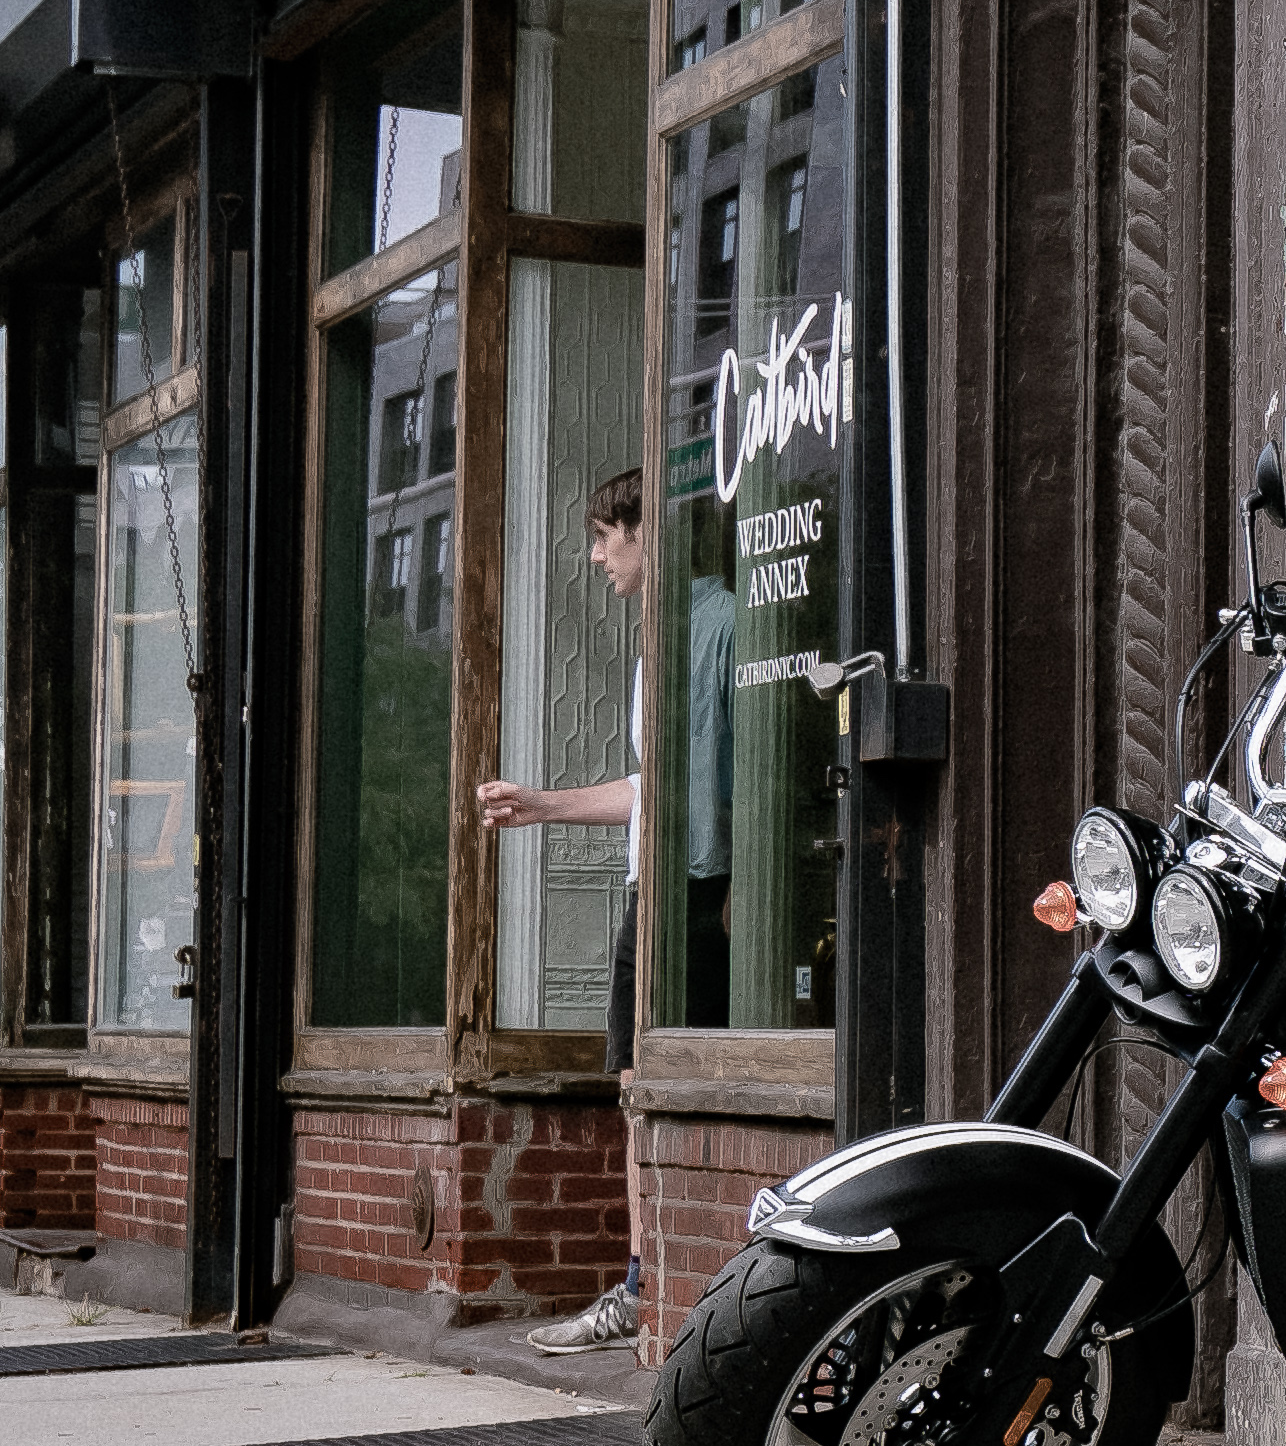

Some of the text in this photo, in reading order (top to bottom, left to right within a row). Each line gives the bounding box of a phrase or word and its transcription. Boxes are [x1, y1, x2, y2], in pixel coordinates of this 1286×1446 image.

[714, 290, 842, 504] Catbird
[737, 498, 822, 559] WEDDING
[747, 555, 810, 609] ANNEX
[735, 649, 821, 689] CATBIRDNYC.COM
